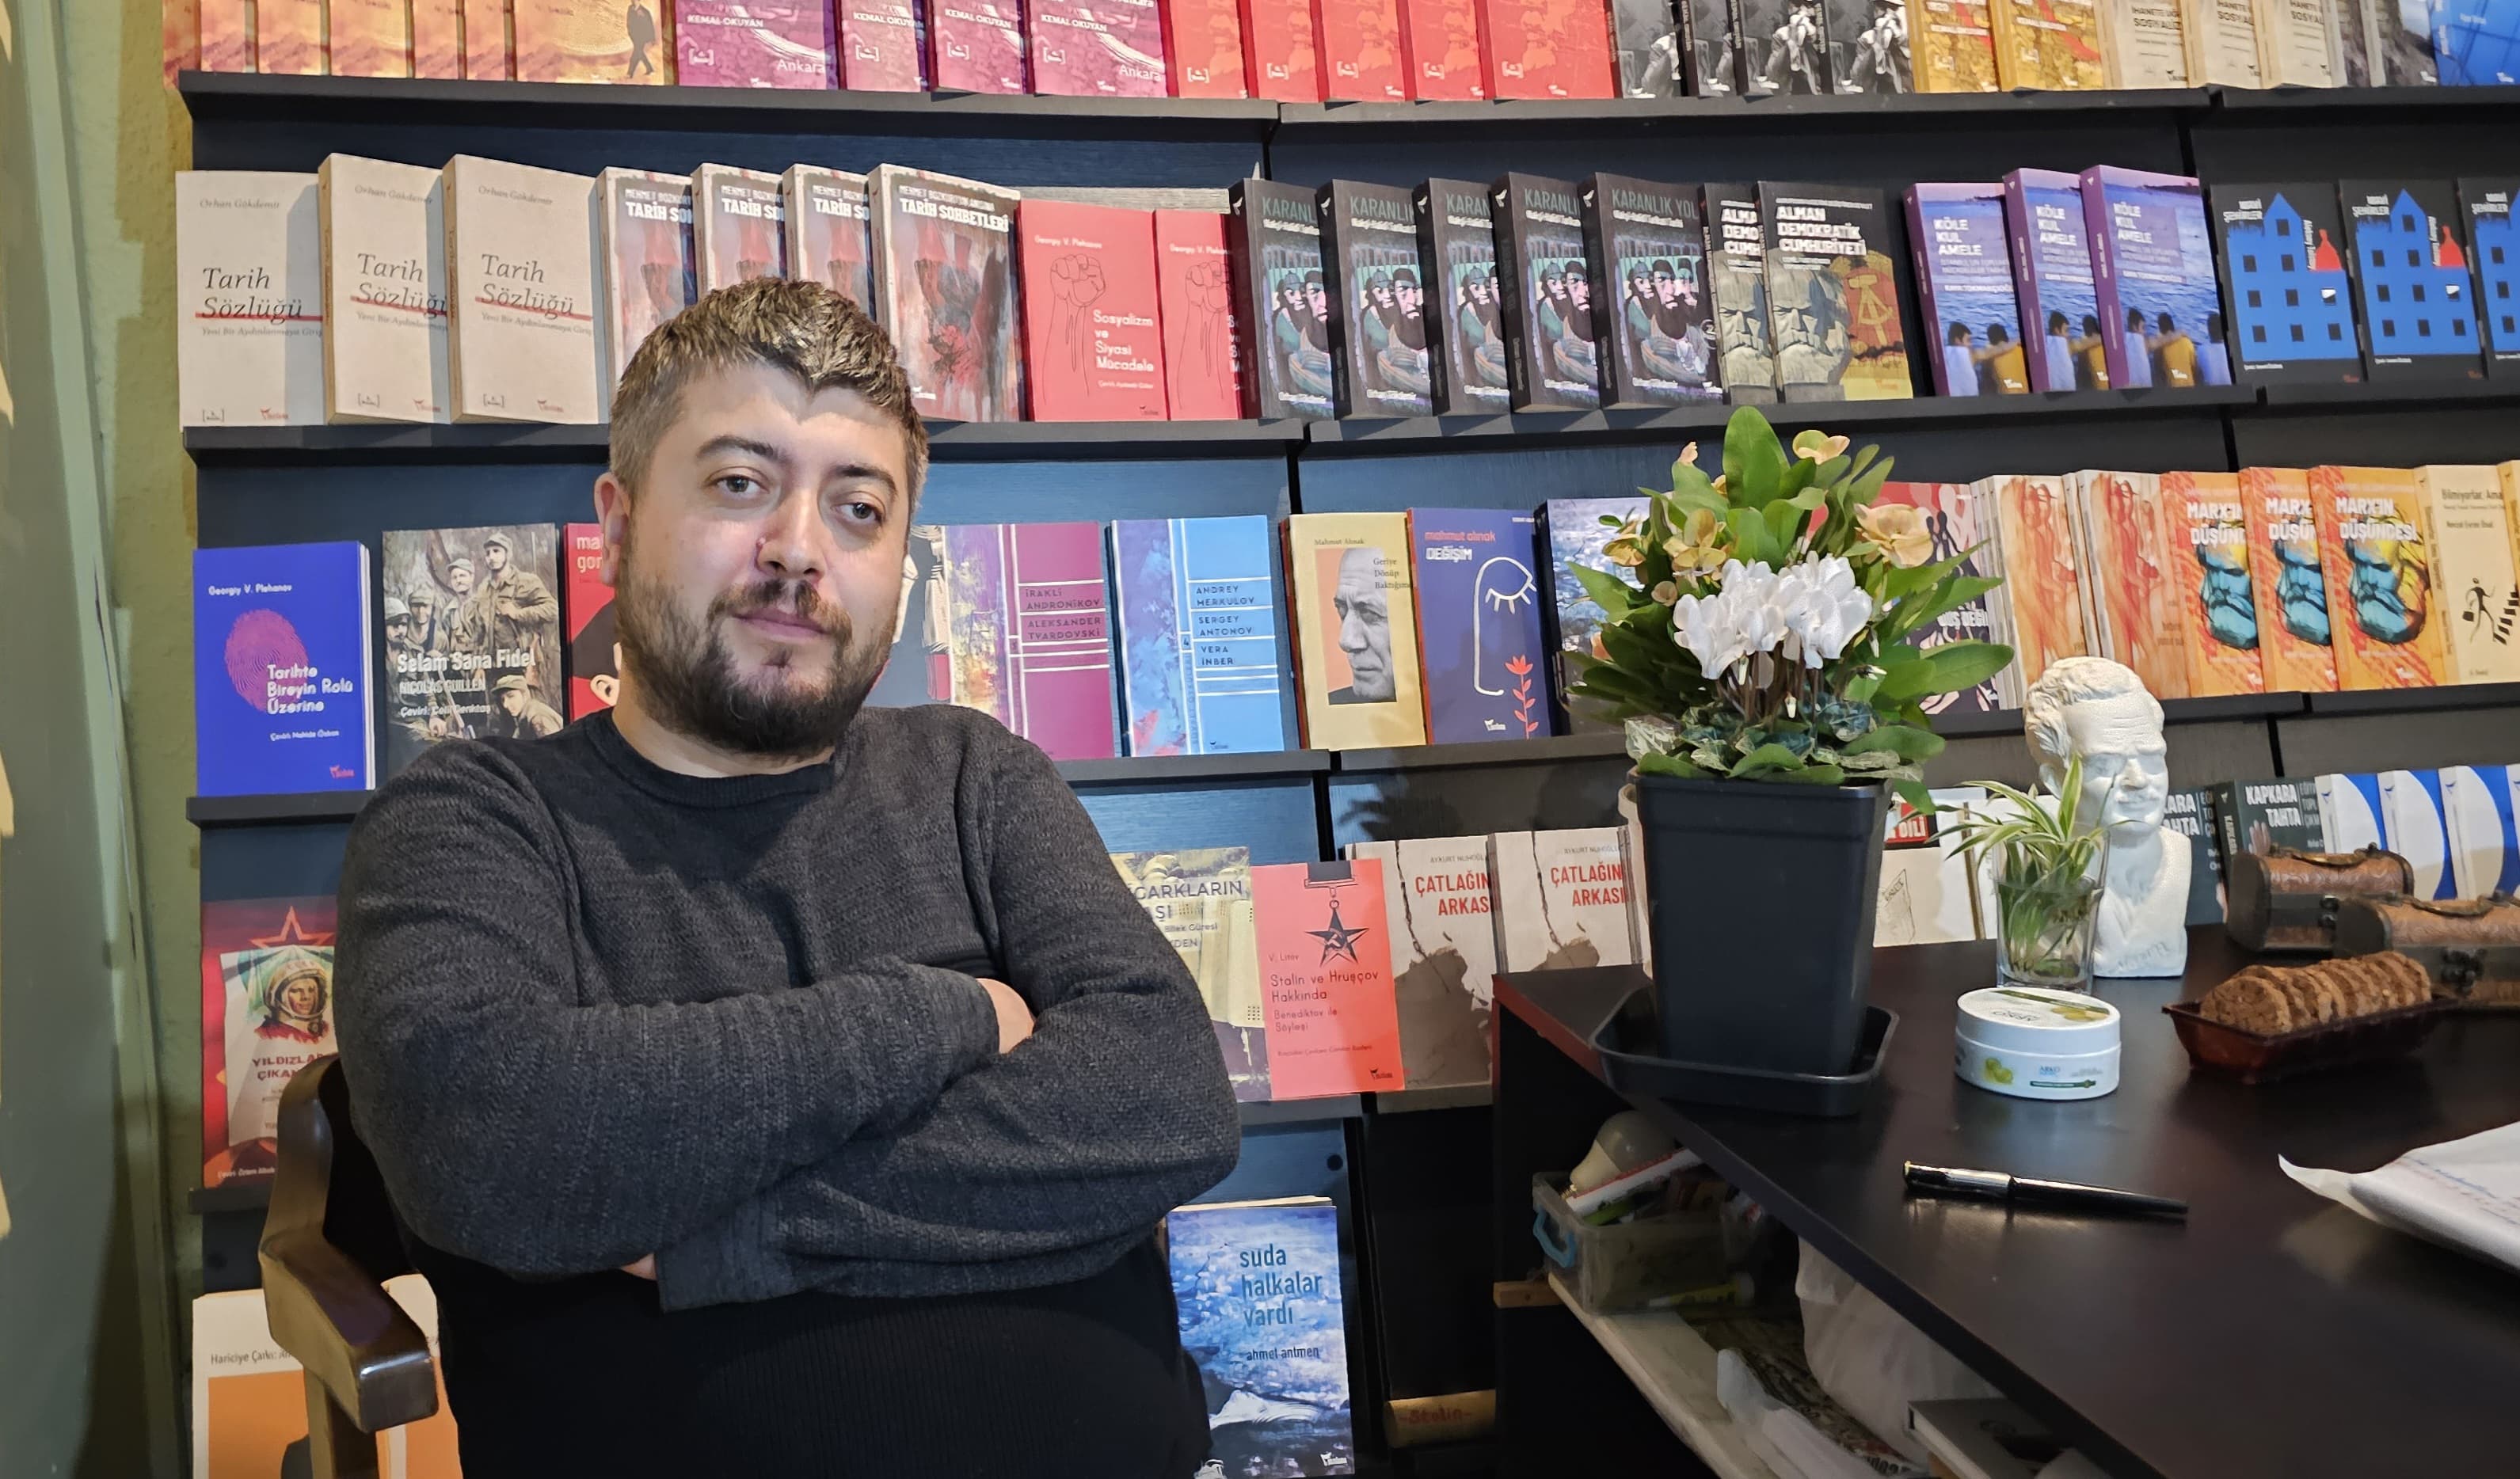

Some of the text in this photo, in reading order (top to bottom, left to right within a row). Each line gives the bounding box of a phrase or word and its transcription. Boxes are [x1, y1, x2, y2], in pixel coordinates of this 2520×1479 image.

[687, 14, 763, 29] KEMAL OKUYAN
[852, 12, 885, 25] KEMAL
[944, 9, 975, 21] KEMAL
[1041, 14, 1071, 27] KEMAL
[776, 59, 826, 74] Ankara
[1118, 64, 1162, 82] Ankara
[625, 200, 668, 222] TARİH
[721, 197, 763, 219] TARİH
[813, 197, 853, 218] TARİH
[1611, 188, 1673, 215] KARANLIK
[1675, 198, 1700, 220] YOL
[2035, 203, 2065, 220] KÖLE
[2113, 200, 2141, 218] KÖLE
[900, 197, 1010, 233] TARİH SOHBETLERİ
[1776, 206, 1826, 222] ALMAN
[1777, 222, 1863, 240] DEMOKRATİK
[1933, 216, 1970, 231] KÖLE
[2037, 218, 2061, 232] KUL
[1936, 231, 1962, 244] KUL
[1779, 238, 1867, 257] CUMHURİYETİ
[1938, 244, 1983, 256] AMELE
[357, 253, 424, 283] Tarih
[482, 253, 545, 283] Tarih
[203, 268, 270, 290] Tarih
[203, 296, 303, 325] Sözlüğü
[482, 283, 575, 320] Sözlüğü
[1093, 310, 1154, 328] Sosyalizm
[1094, 329, 1109, 339] ve
[1095, 341, 1132, 357] Siyasi
[1097, 356, 1155, 372] Mücadele
[1424, 531, 1465, 542] mahmut
[2339, 517, 2418, 544] DÜŞÜNCESİ
[1372, 557, 1398, 567] Geriye
[1374, 568, 1400, 579] Dönüp
[244, 584, 253, 594] V.
[255, 583, 292, 594] Plehanov
[1025, 587, 1063, 598] İRAKLİ
[1196, 585, 1239, 595] ANDREY
[1026, 598, 1101, 610] ANDRONİKOV
[1197, 597, 1254, 606] MERKULOV
[1027, 616, 1102, 628] ALEKSANDER
[1198, 615, 1239, 624] SERGEY
[1028, 628, 1101, 641] TVARDOVSKİ
[1199, 626, 1253, 637] ANTONOV
[397, 647, 536, 673] Selam Sana Fidel
[1201, 656, 1235, 666] İNBER
[266, 663, 318, 680] Tarihte
[266, 678, 353, 699] Bireyin Rolü
[266, 697, 325, 715] Üzerine
[2244, 783, 2297, 805] KAPKARA
[2164, 793, 2197, 814] ARA
[2162, 816, 2200, 836] AHTA
[2264, 807, 2301, 827] TAHTA
[1415, 869, 1490, 897] ÇATLAĞIN
[1551, 861, 1623, 888] ÇATLAĞIN
[1132, 880, 1243, 900] GARKLARIN
[1572, 887, 1627, 907] ARKASI
[1270, 968, 1380, 987] Stalin ve Hruşçov
[1271, 988, 1328, 1003] Hakkında
[1273, 1008, 1338, 1020] Benediktov ile
[1239, 1242, 1287, 1268] suda
[1241, 1271, 1323, 1298] halkalar
[1243, 1305, 1293, 1328] vardı
[211, 1348, 277, 1366] Hariciye Çarkı:
[1247, 1345, 1319, 1361] ahmet antmen
